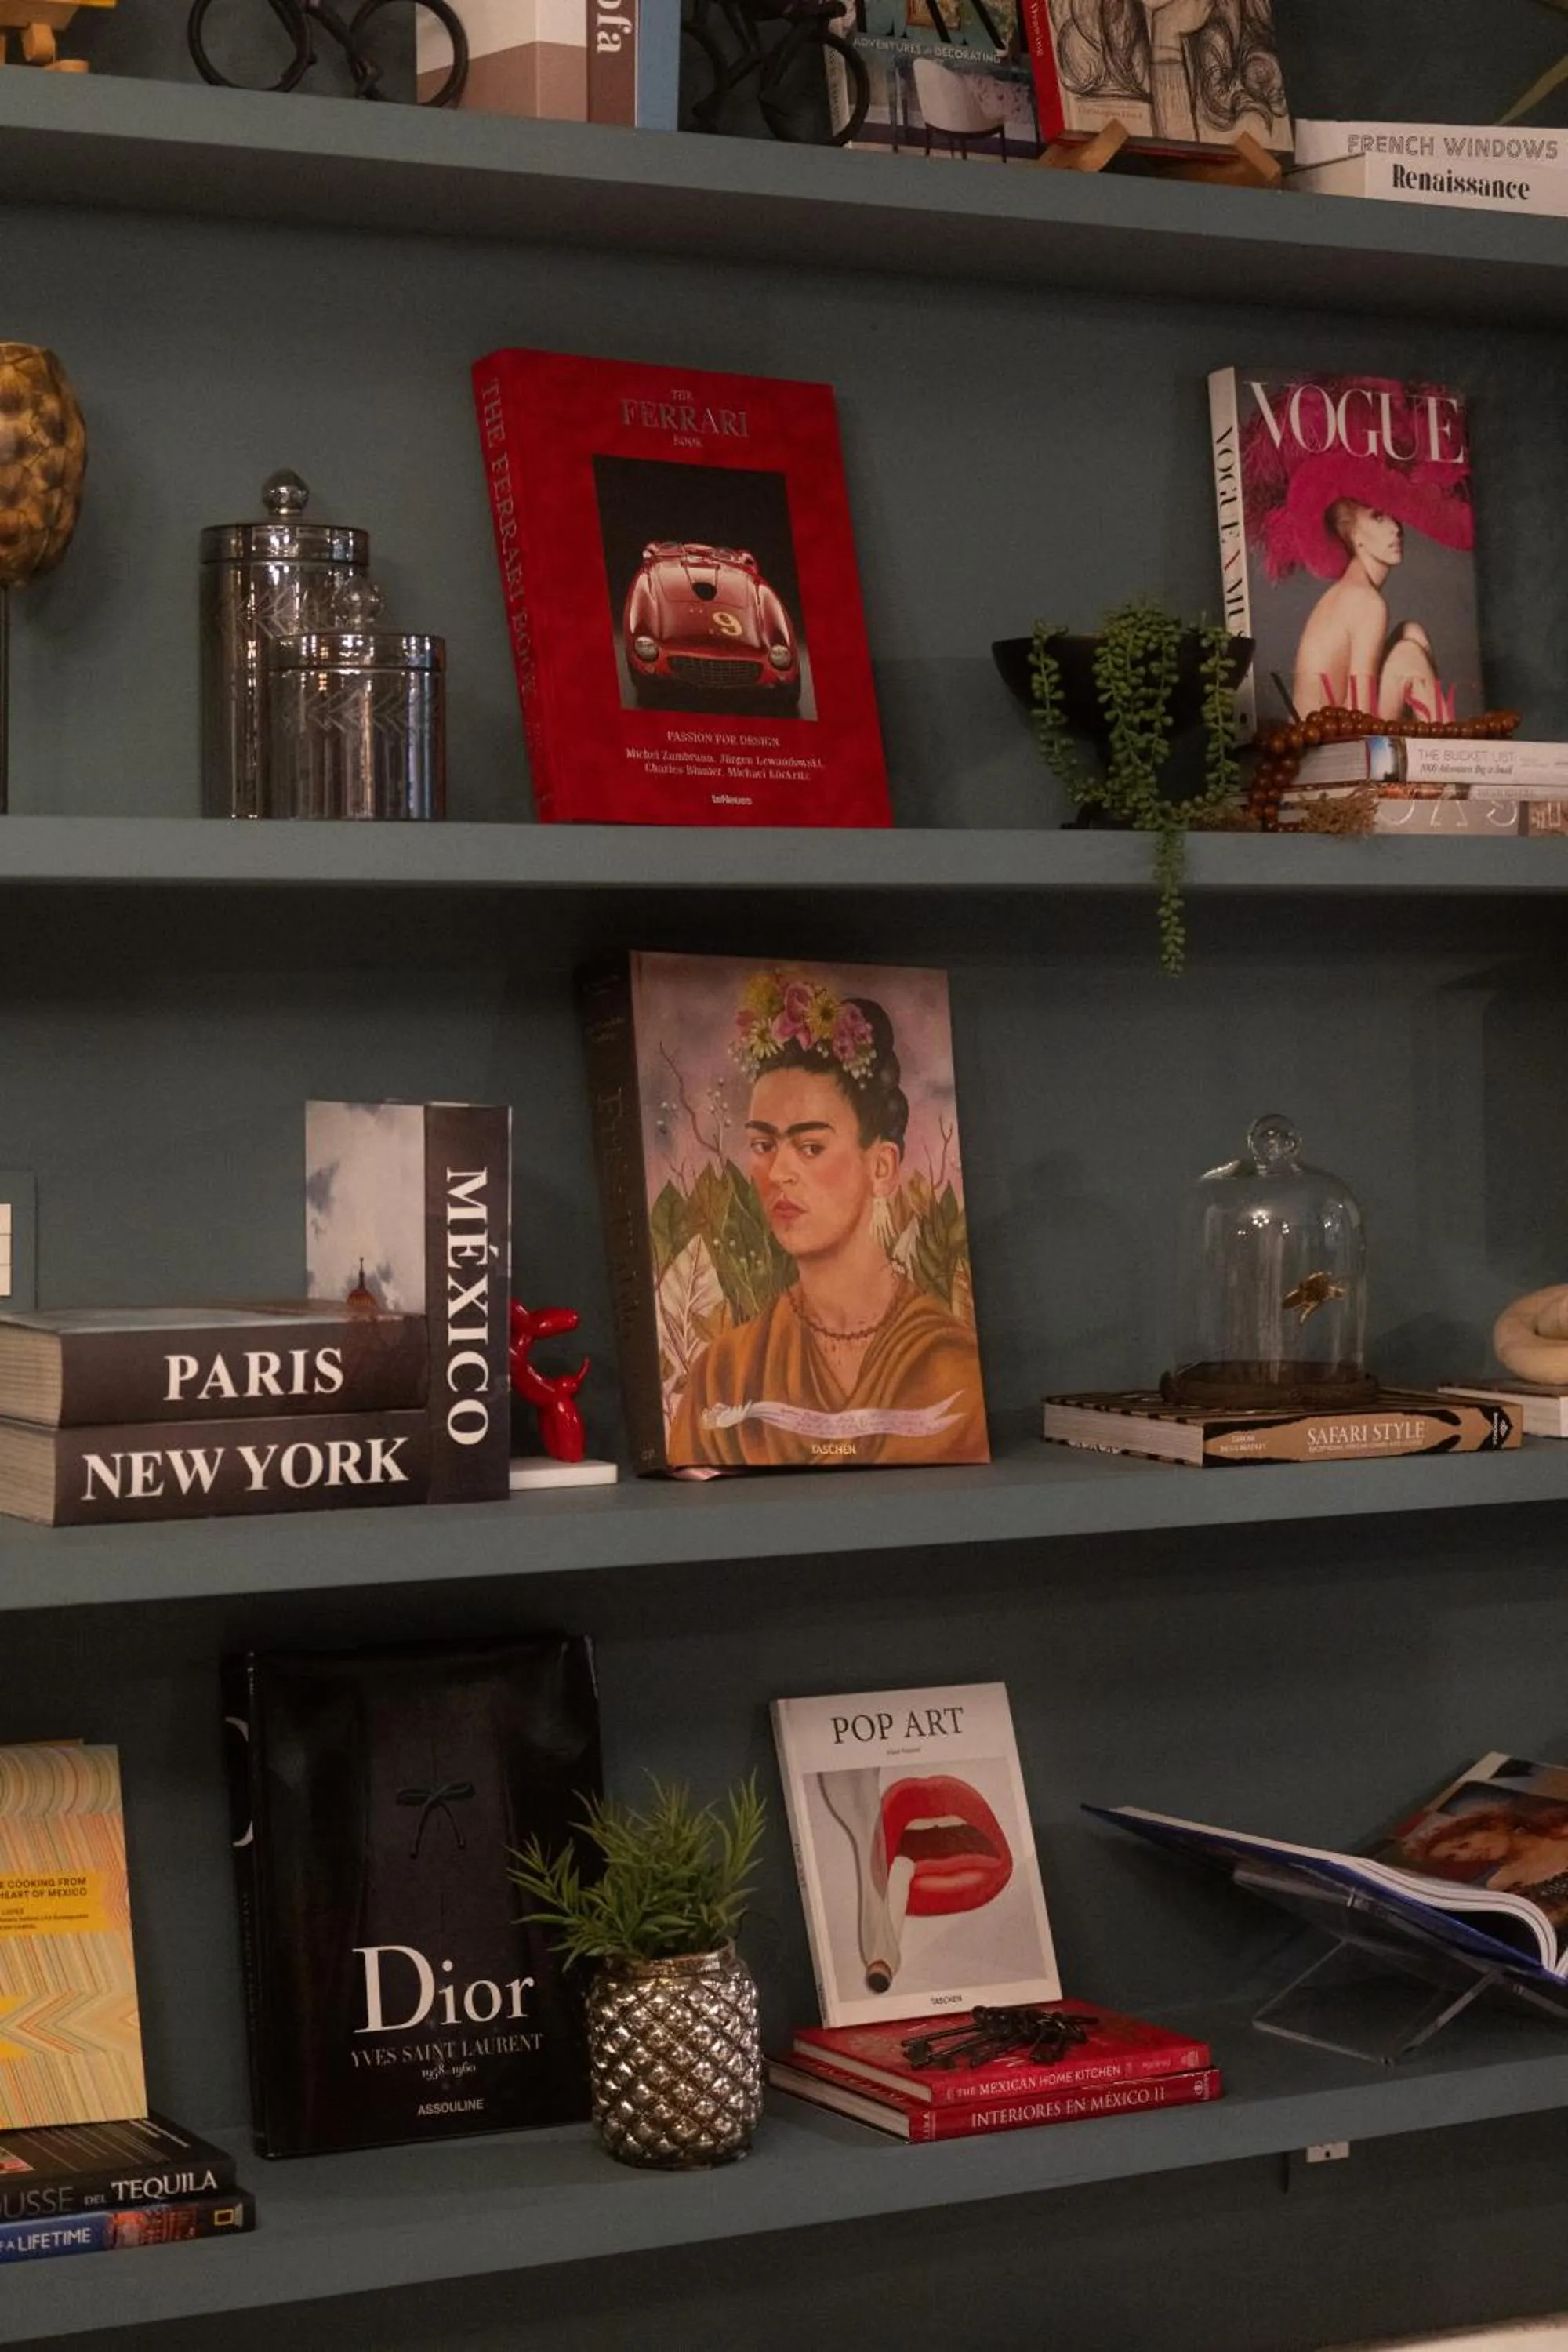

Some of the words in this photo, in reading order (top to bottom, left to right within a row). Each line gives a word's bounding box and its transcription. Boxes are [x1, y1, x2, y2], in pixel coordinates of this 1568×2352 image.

[853, 37, 922, 56] ADVENTURES
[935, 45, 1001, 64] DECORATING
[1347, 133, 1435, 156] FRENCH
[1441, 136, 1558, 160] WINDOWS
[1392, 163, 1530, 201] Renaissance
[482, 378, 506, 448] THE
[620, 397, 750, 438] FERRARI
[1243, 381, 1465, 463] VOGUE
[1215, 426, 1241, 544] VOGUE
[491, 452, 527, 603] FERRARI
[666, 730, 713, 743] PASSION
[1417, 748, 1440, 760] THE
[1443, 750, 1489, 762] BUCKET
[445, 1166, 499, 1446] MÉXICO
[162, 1347, 345, 1401] PARIS
[811, 1443, 857, 1455] TASCHEN
[1307, 1425, 1367, 1444] SAFARI
[1373, 1421, 1425, 1441] STYLE
[80, 1447, 226, 1501] NEW
[236, 1436, 410, 1492] YORK
[831, 1712, 894, 1744] POP
[904, 1706, 964, 1738] ART
[7, 1878, 55, 1889] COOKING
[58, 1877, 86, 1886] FROM
[32, 1889, 45, 1898] OF
[49, 1887, 87, 1897] MEXICO
[351, 1945, 535, 2033] Dior
[351, 2048, 397, 2068] YVES
[402, 2041, 456, 2063] SAINT
[462, 2033, 543, 2058] LAURENT
[957, 2086, 976, 2097] THE
[979, 2077, 1036, 2096] MEXICAN
[1039, 2071, 1073, 2086] HOME
[1075, 2064, 1121, 2080] KITCHEN
[417, 2098, 484, 2116] ASSOULINE
[971, 2100, 1061, 2128] INTERIORES
[1066, 2097, 1086, 2114] EN
[1091, 2089, 1150, 2111] MÉXICO
[0, 2186, 74, 2219] USSE
[84, 2194, 107, 2205] DEL
[111, 2169, 218, 2201] TEQUILA
[18, 2227, 93, 2252] LIFETIME
